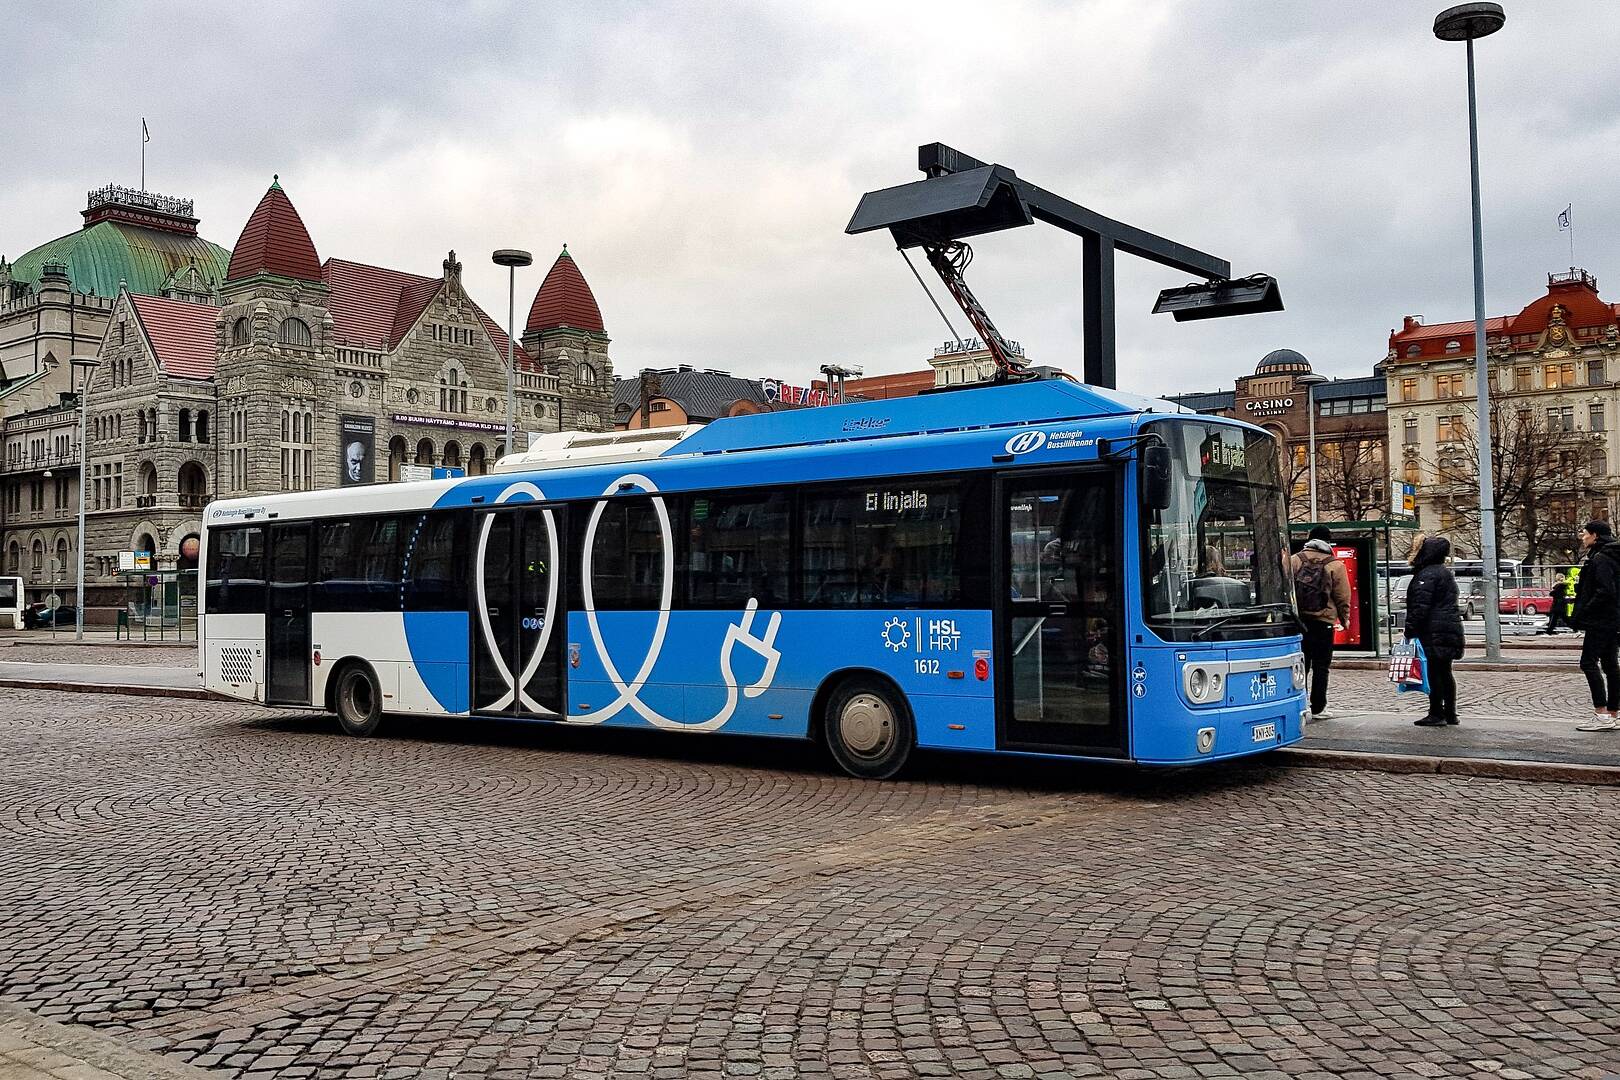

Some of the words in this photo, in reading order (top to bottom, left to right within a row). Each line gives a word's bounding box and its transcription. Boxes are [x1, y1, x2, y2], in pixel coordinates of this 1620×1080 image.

[944, 338, 979, 353] PLAZA
[1246, 398, 1293, 410] CASINO
[1253, 409, 1286, 417] HELSINKI
[1049, 430, 1083, 440] Helsingin
[866, 492, 878, 511] Ei
[883, 489, 928, 513] linjalla
[929, 620, 961, 635] HSL
[929, 636, 961, 651] HRT
[914, 659, 940, 674] 1612
